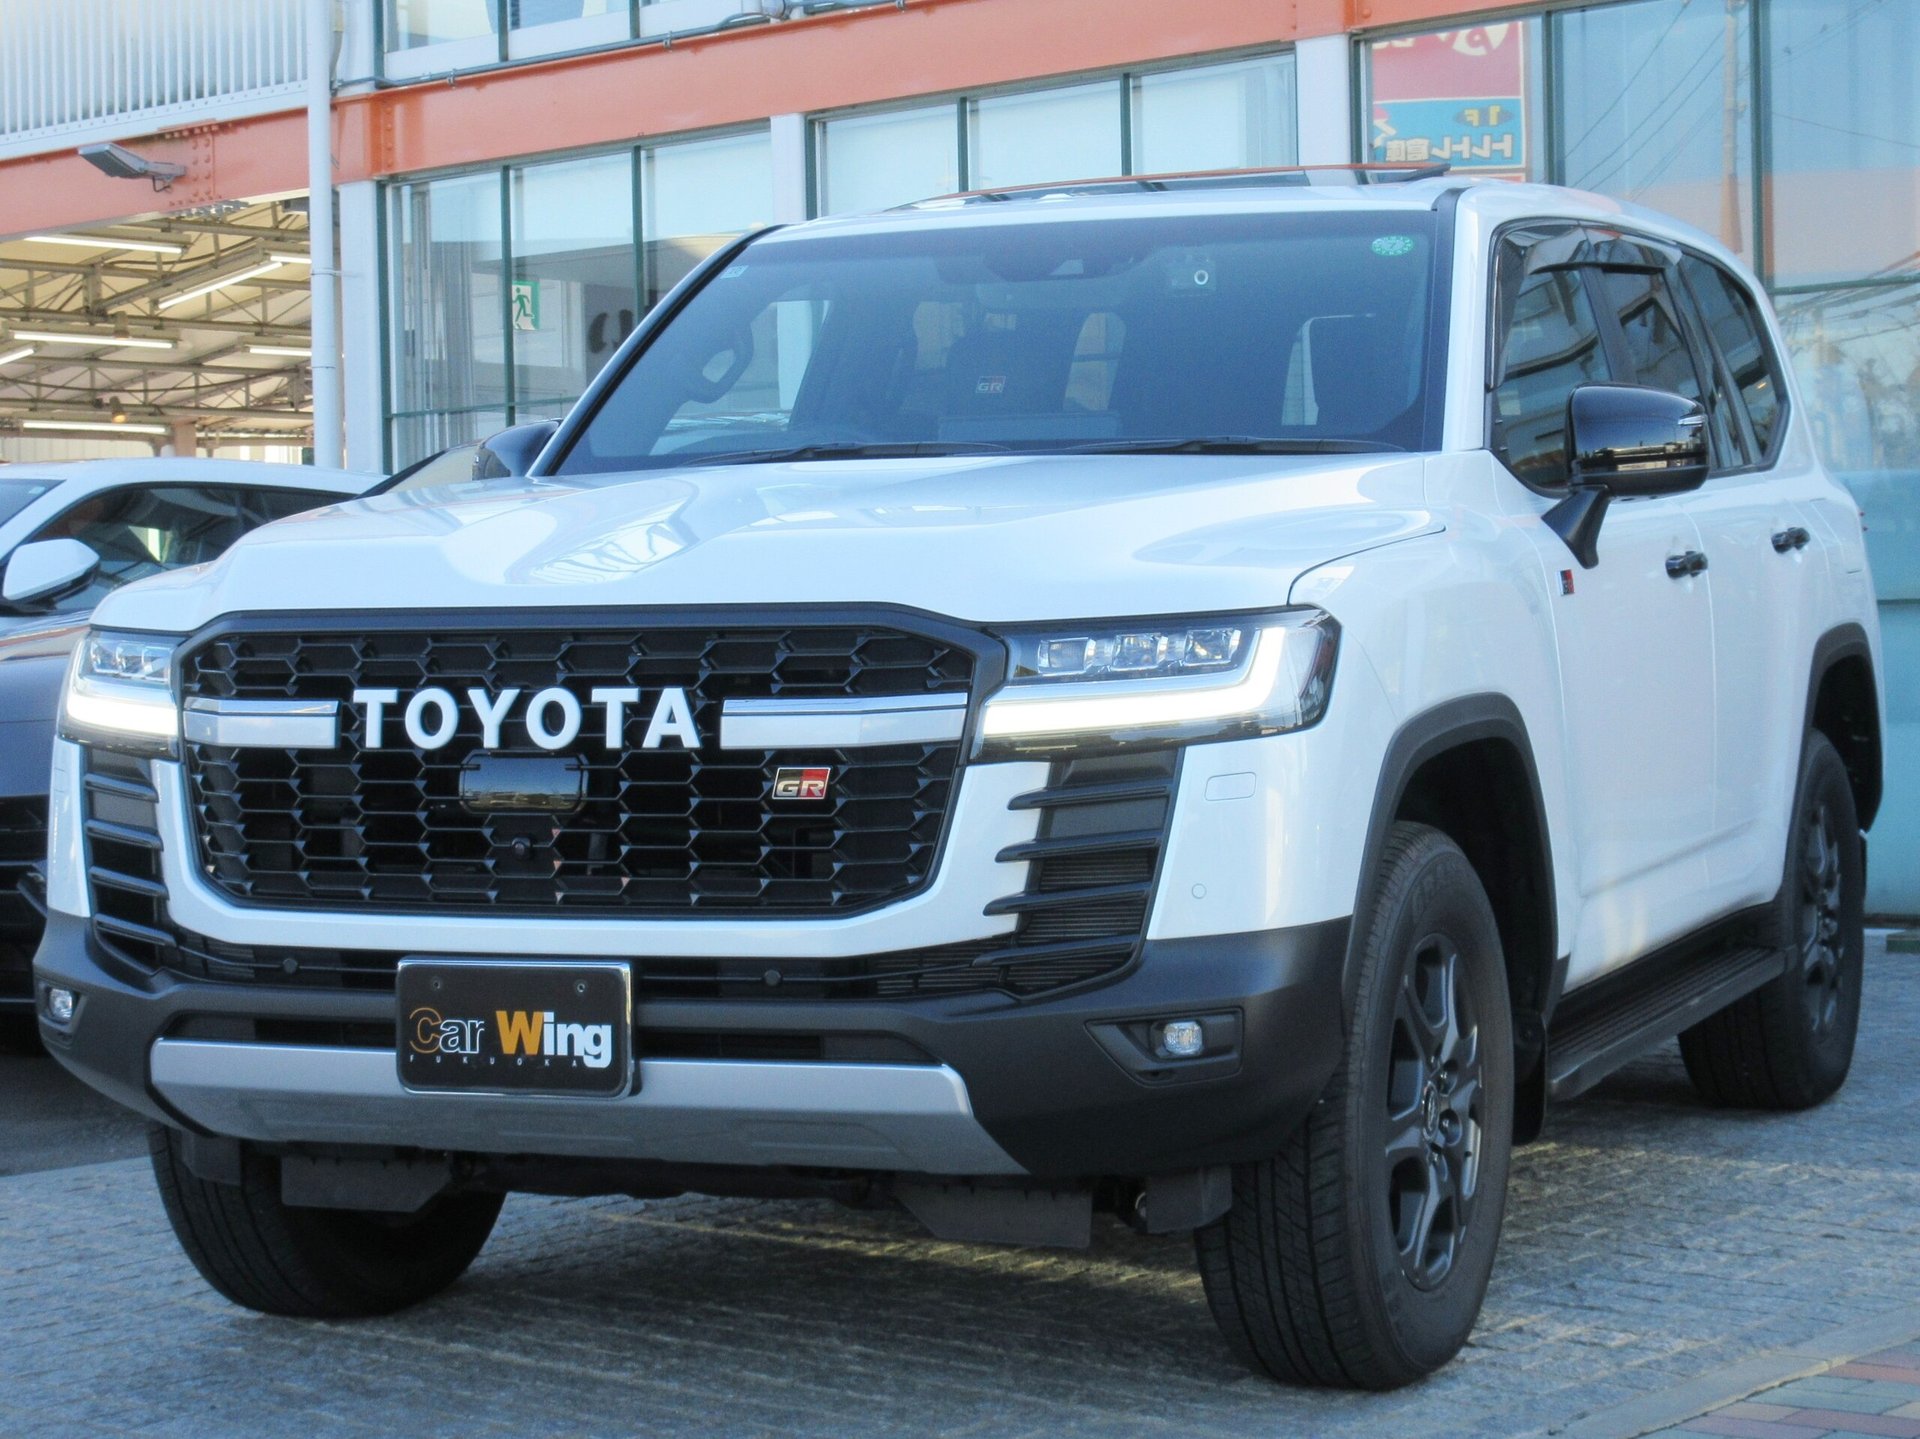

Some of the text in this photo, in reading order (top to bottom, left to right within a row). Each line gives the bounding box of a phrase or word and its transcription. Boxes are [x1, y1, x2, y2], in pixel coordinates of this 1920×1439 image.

[353, 687, 701, 750] TOYOTA
[776, 781, 824, 796] GR
[409, 1007, 612, 1069] Car Wing
[409, 1055, 577, 1067] FUKUOKA
